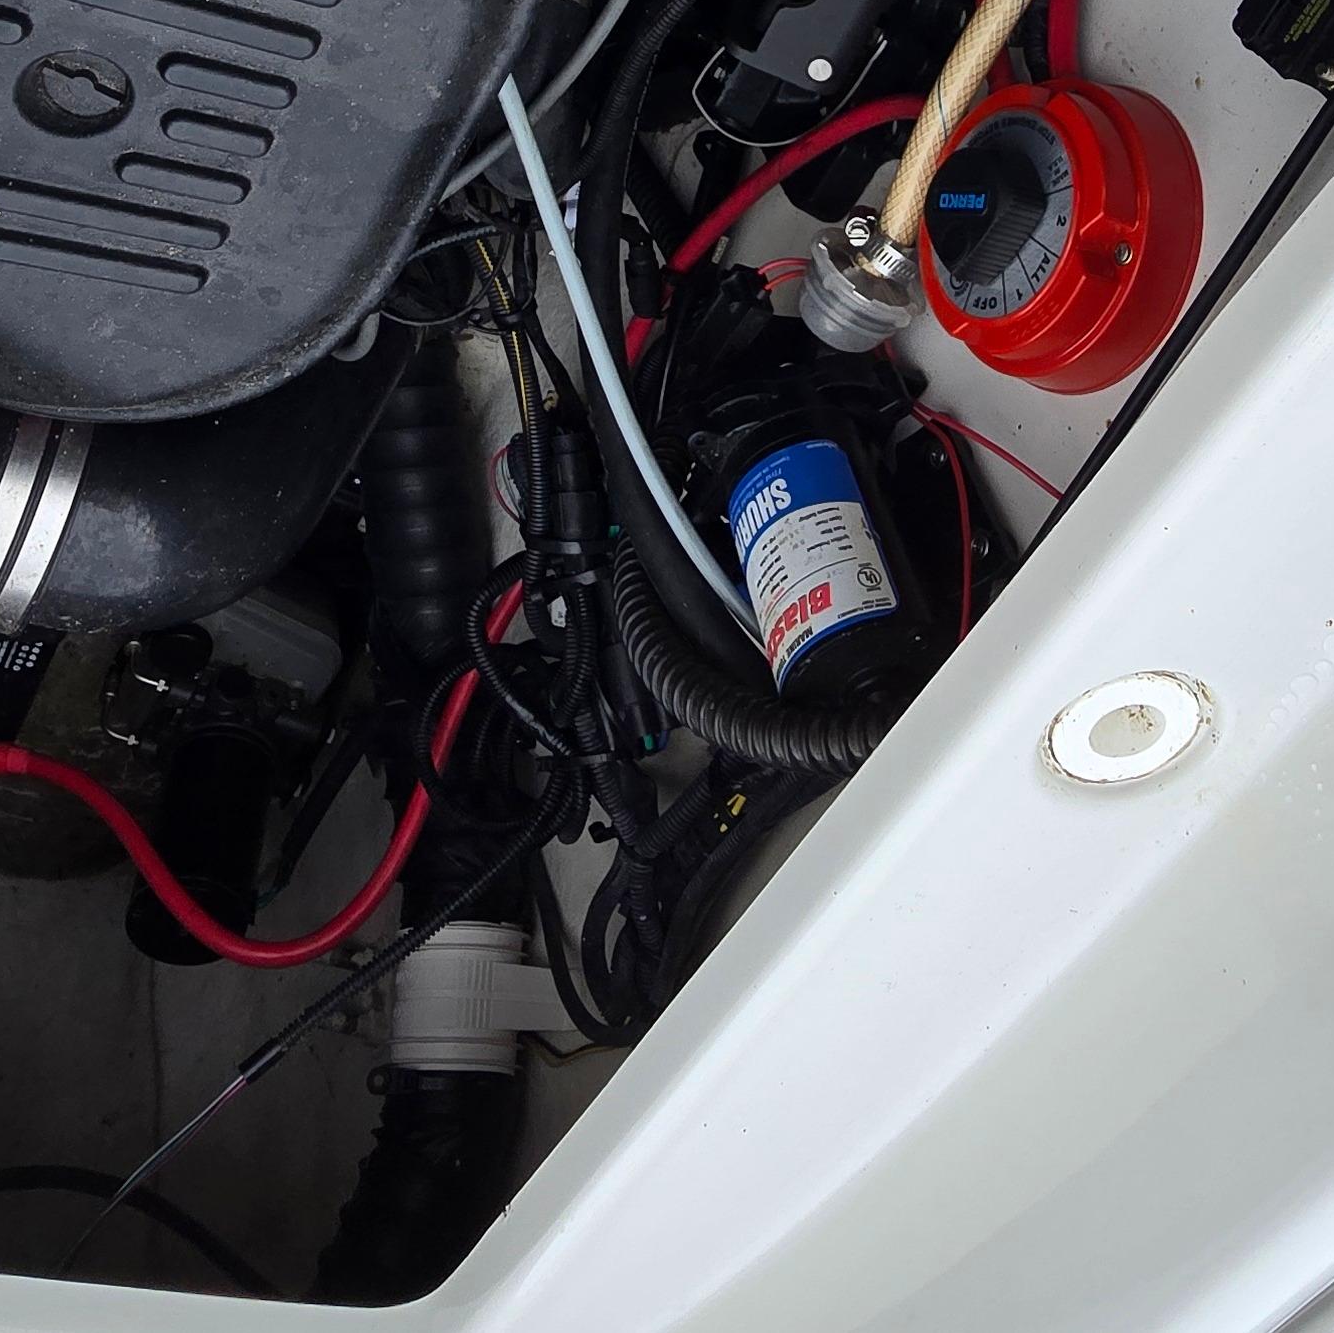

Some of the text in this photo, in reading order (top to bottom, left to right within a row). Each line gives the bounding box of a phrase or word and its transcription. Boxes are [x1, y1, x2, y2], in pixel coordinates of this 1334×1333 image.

[939, 193, 986, 209] PERKO
[1056, 215, 1067, 227] 2
[1031, 252, 1052, 283] ALL
[1016, 288, 1024, 301] 1
[972, 296, 998, 310] OFF
